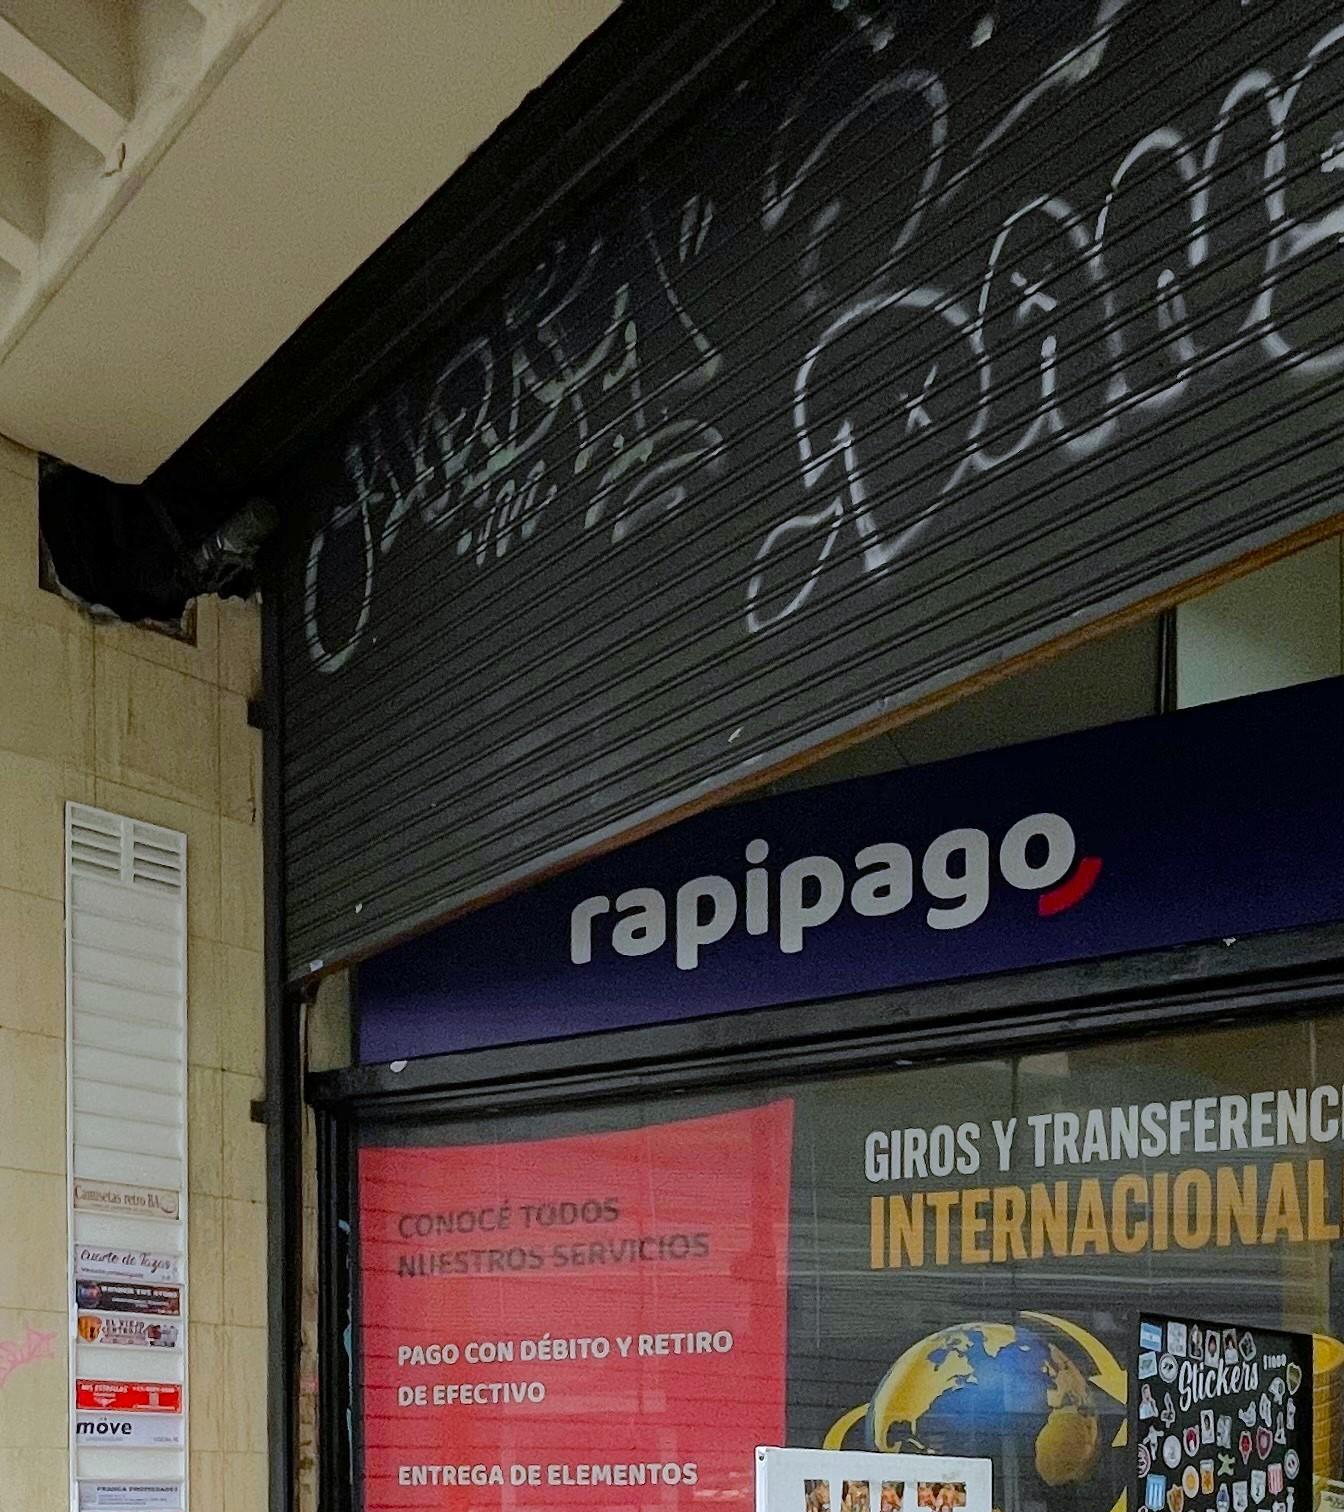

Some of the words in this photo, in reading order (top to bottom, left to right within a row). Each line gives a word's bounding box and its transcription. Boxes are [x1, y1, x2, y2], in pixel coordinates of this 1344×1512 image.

[569, 811, 1076, 971] rapipago
[864, 1117, 981, 1183] GIROS
[991, 1116, 1018, 1172] Y
[397, 1200, 510, 1240] CONOCÉ
[520, 1198, 620, 1229] TODOS
[121, 1252, 136, 1266] de
[397, 1246, 544, 1278] NUESTROS
[552, 1232, 711, 1268] SERVICIOS
[398, 1343, 459, 1367] PAGO
[464, 1340, 514, 1364] CON
[520, 1333, 610, 1361] DÉBITO
[615, 1336, 633, 1358] Y
[637, 1330, 733, 1356] RETIRO
[398, 1385, 428, 1406] DE
[432, 1382, 546, 1406] EFECTIVO
[1178, 1358, 1259, 1412] Stickers
[76, 1421, 132, 1435] move
[398, 1464, 505, 1486] ENTREGA
[510, 1464, 541, 1486] DE
[547, 1462, 698, 1486] ELEMENTOS
